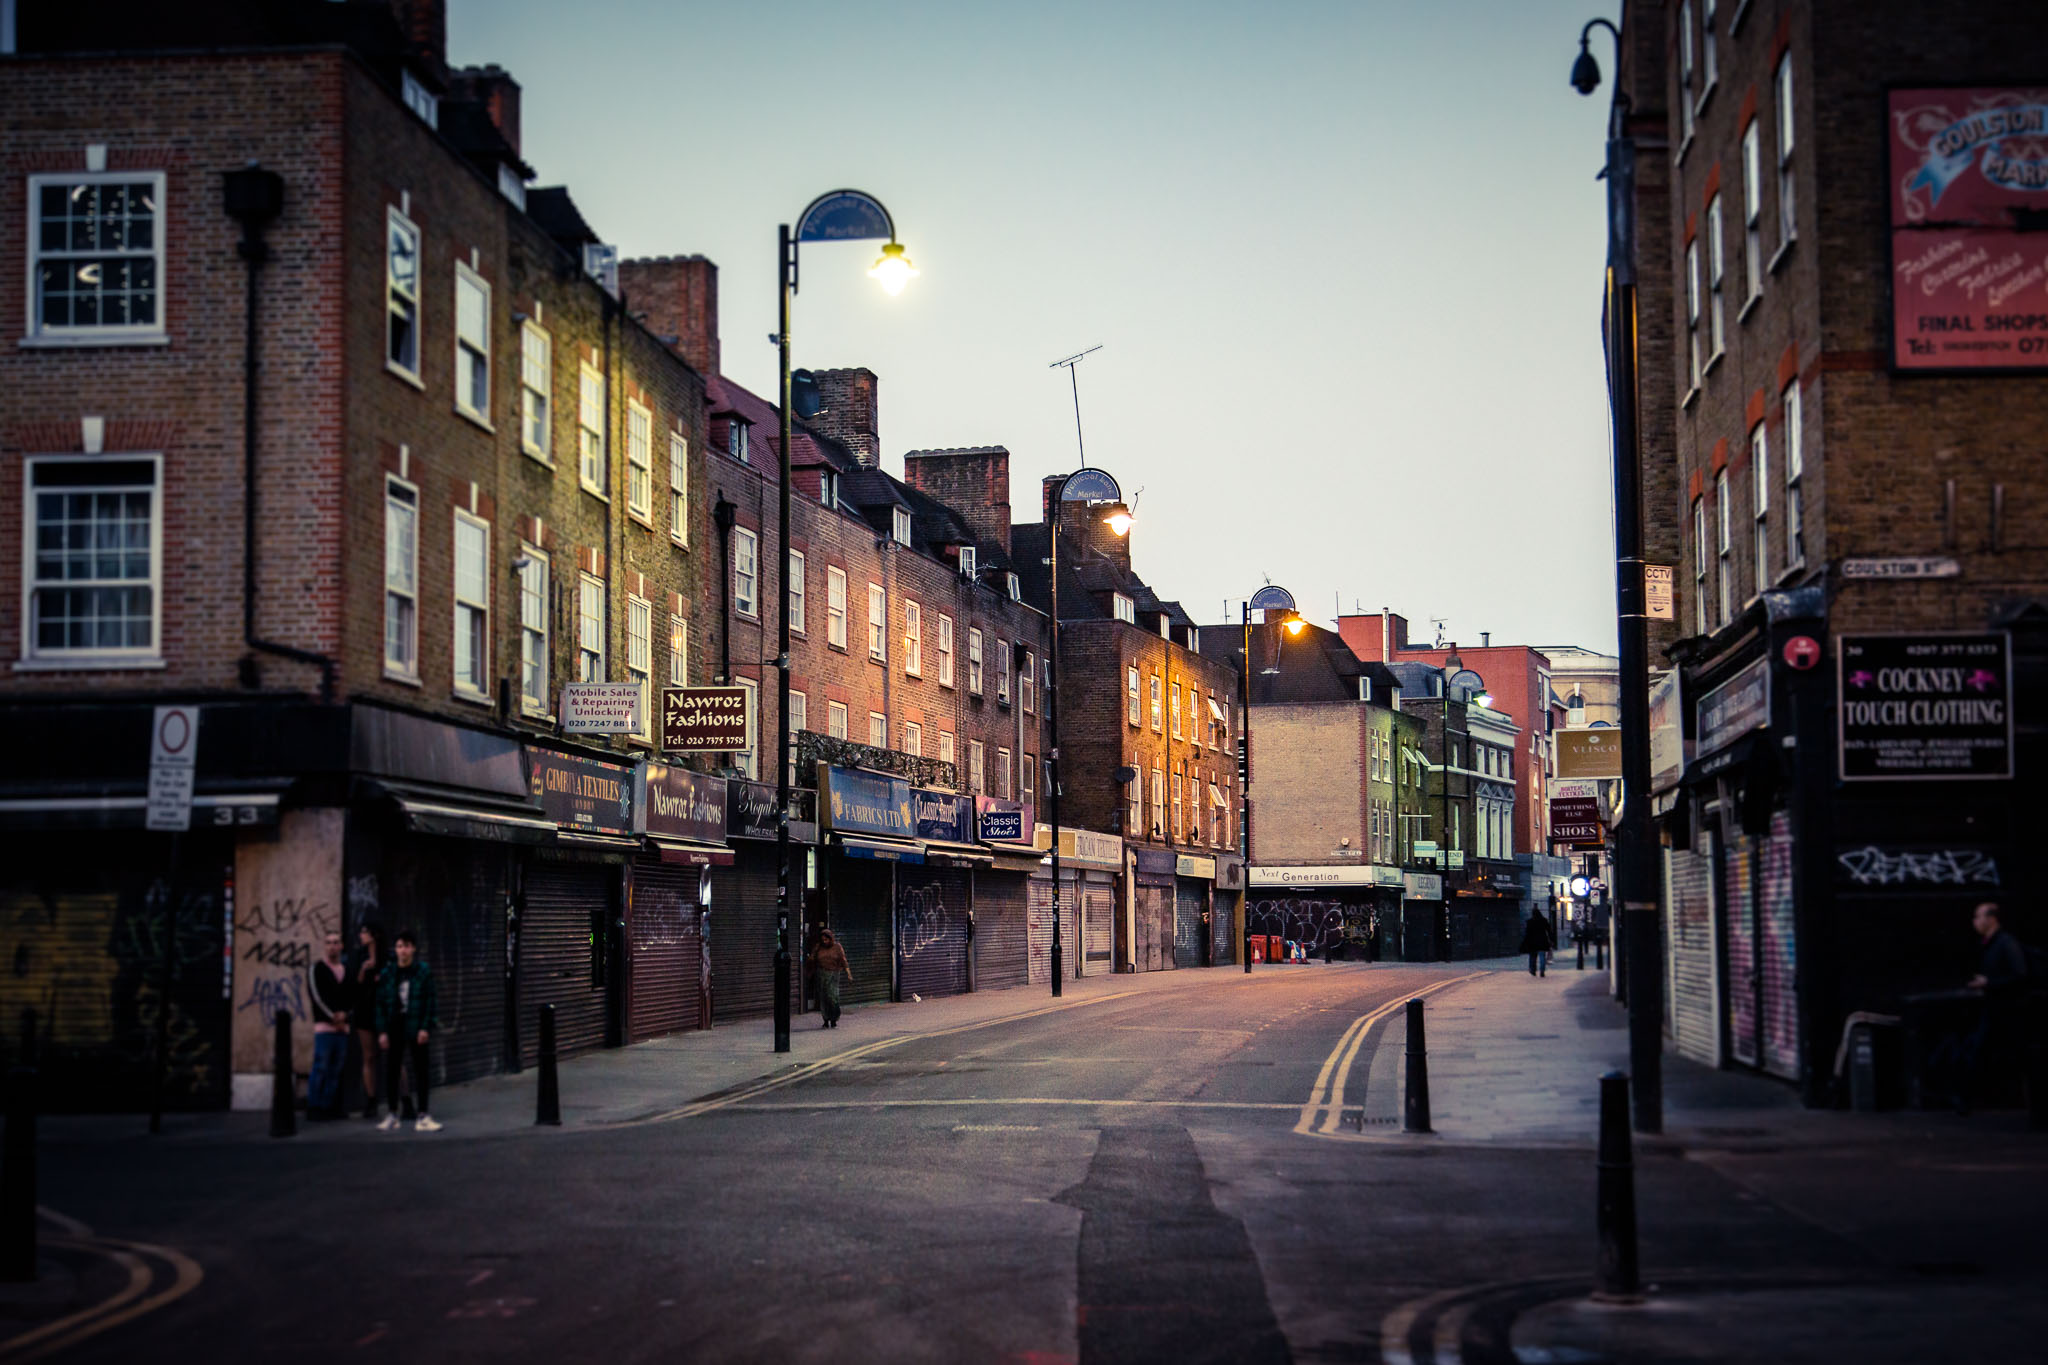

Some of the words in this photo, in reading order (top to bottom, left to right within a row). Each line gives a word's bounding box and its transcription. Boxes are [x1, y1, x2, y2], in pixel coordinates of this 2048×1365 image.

[1934, 109, 2044, 158] GOULSTON
[1918, 314, 1976, 333] FINAL
[1906, 337, 1937, 355] Tel:
[1077, 490, 1103, 498] Market
[1646, 568, 1671, 579] CCTV
[1877, 667, 1967, 693] COCKNEY
[568, 687, 607, 697] Mobile
[610, 687, 638, 697] Sales
[571, 698, 580, 706] &
[582, 697, 635, 709] Repairing
[667, 692, 743, 709] Nawroz
[575, 707, 630, 719] Unlocking
[665, 708, 745, 727] Fashions
[1844, 699, 1909, 726] TOUCH
[1909, 699, 2005, 726] CLOTHING
[665, 734, 684, 745] Tel:
[686, 736, 704, 745] 020
[706, 736, 725, 746] 7375
[726, 736, 745, 745] 3758
[1572, 744, 1617, 753] VLISCO
[582, 774, 620, 803] TEXTILES
[653, 783, 688, 820] Nawroz
[688, 786, 722, 825] Fashions
[845, 802, 883, 826] FABRICS
[883, 809, 901, 828] LTD
[982, 813, 1020, 826] Classic
[986, 826, 1016, 836] Shoes
[1553, 825, 1597, 838] SHOES
[1258, 868, 1280, 878] Next
[1281, 872, 1340, 882] Generation
